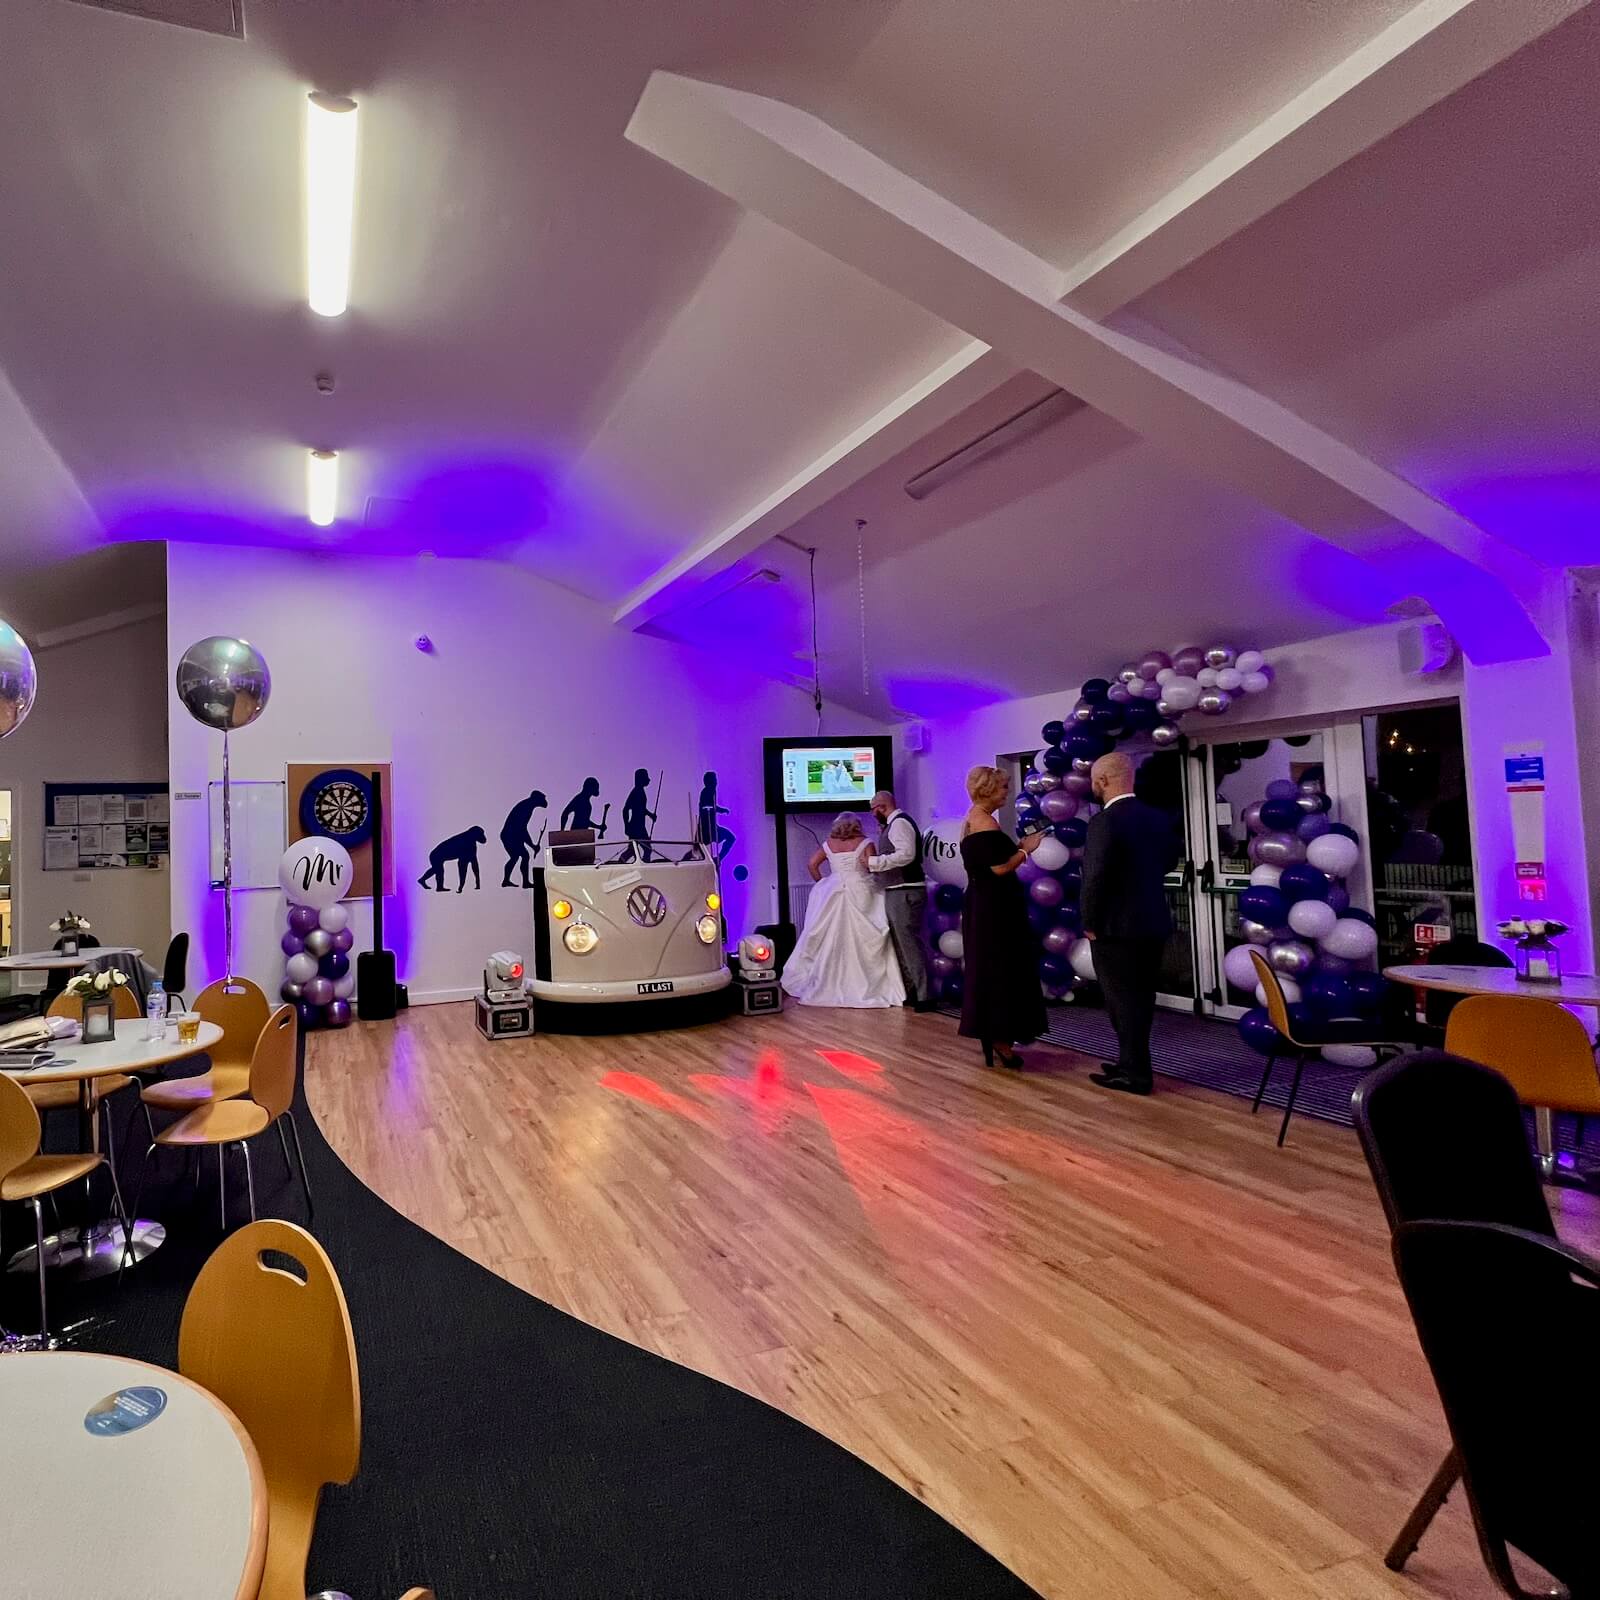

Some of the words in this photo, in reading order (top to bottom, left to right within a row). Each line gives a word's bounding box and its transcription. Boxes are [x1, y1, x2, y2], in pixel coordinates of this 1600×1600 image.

[921, 830, 957, 863] Mrs
[292, 853, 344, 891] Mr
[627, 885, 666, 927] VW
[639, 983, 650, 993] AT
[651, 982, 672, 992] LAST
